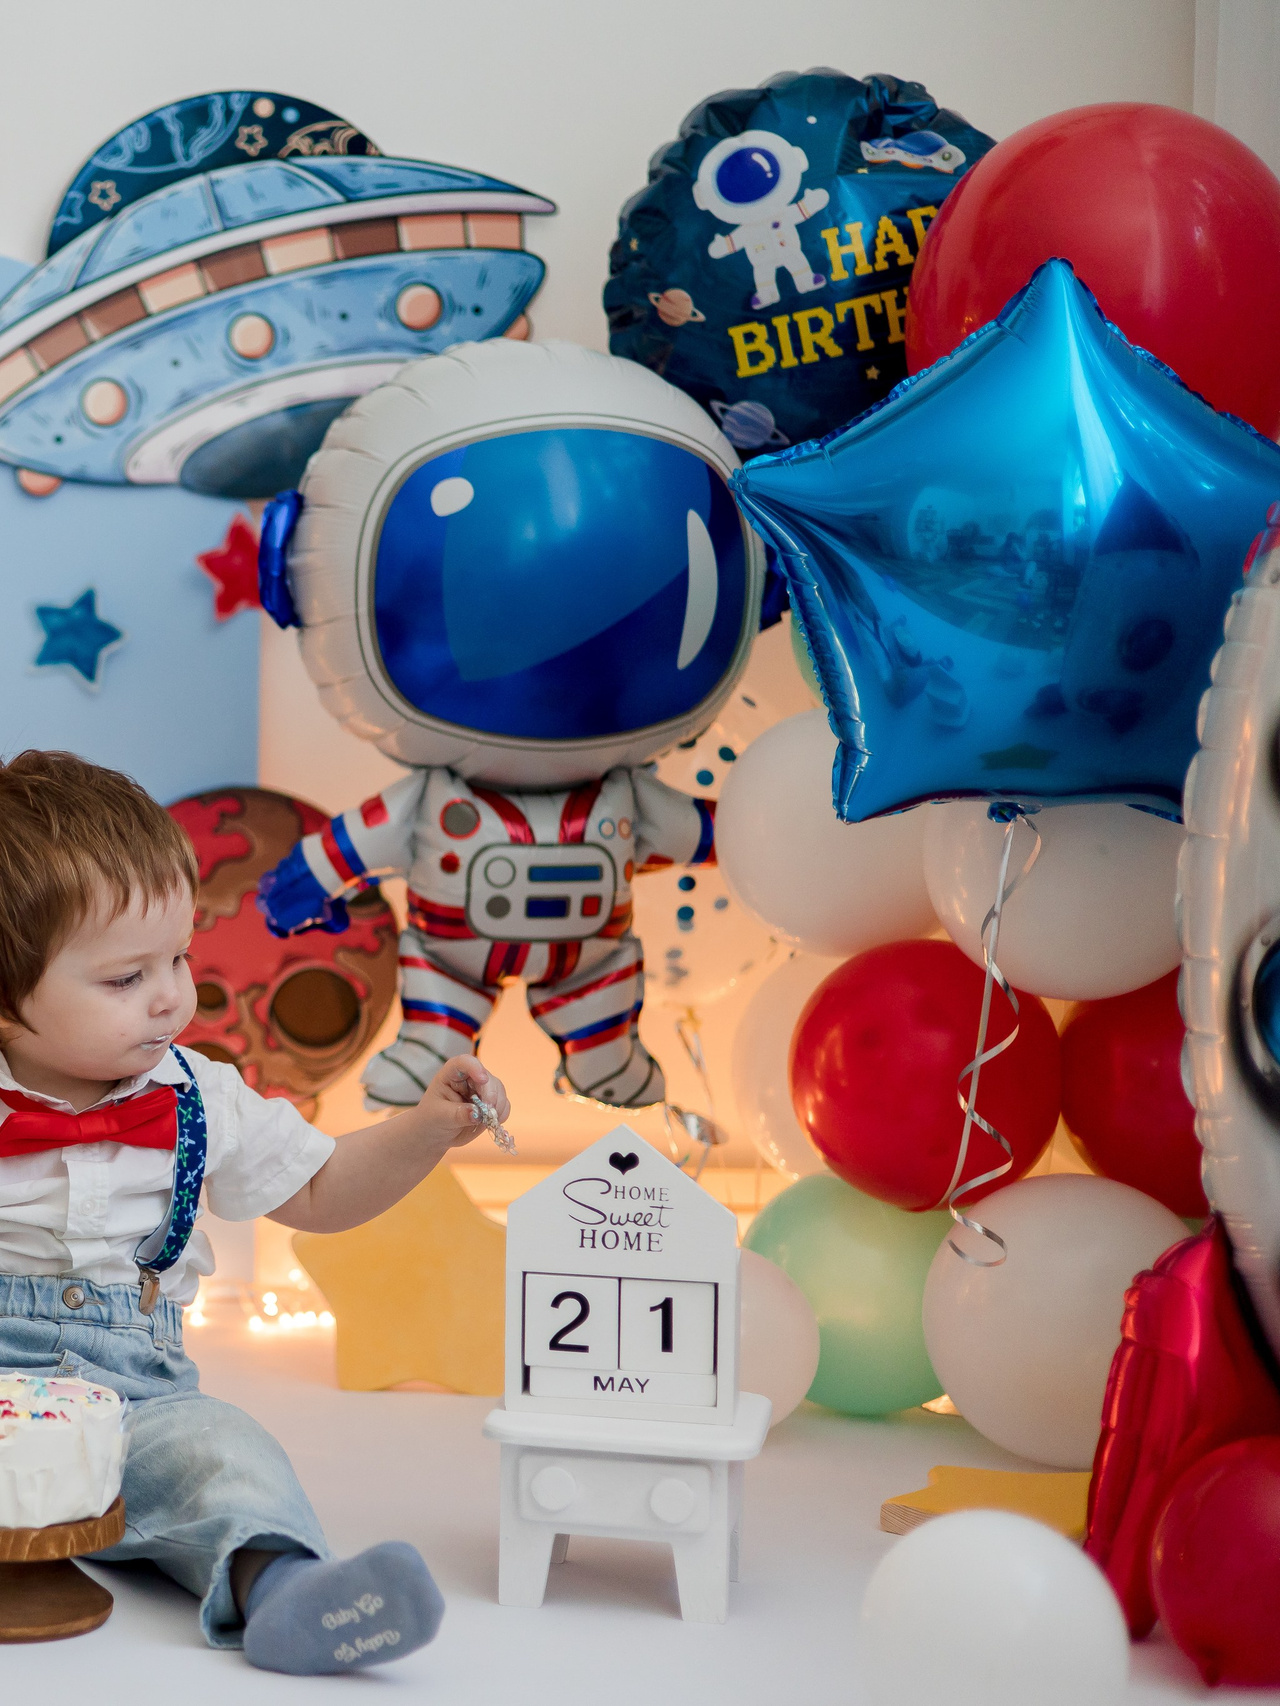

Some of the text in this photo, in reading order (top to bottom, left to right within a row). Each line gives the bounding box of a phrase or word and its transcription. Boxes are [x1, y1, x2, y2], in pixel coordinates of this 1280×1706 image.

[562, 1177, 674, 1228] Sweet
[613, 1185, 670, 1202] HOME
[578, 1228, 664, 1252] HOME
[593, 1375, 650, 1394] MAY
[322, 1593, 384, 1630] Baby Go
